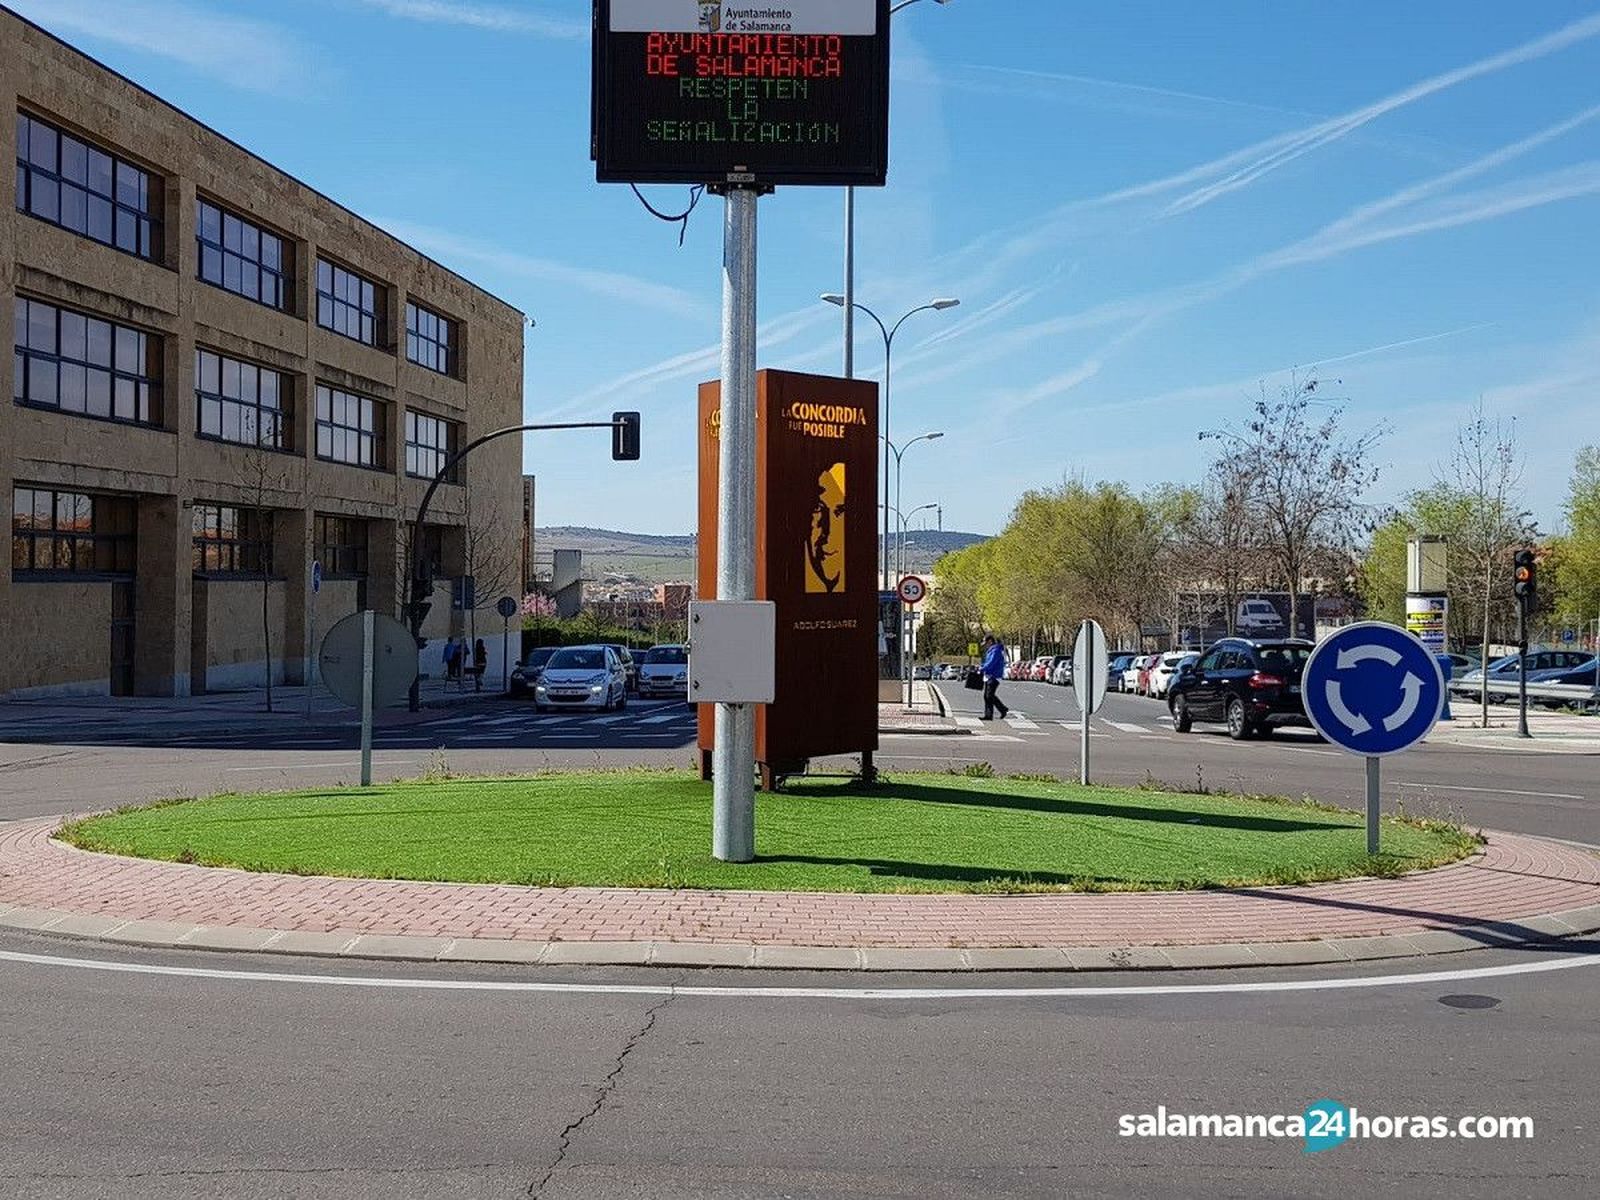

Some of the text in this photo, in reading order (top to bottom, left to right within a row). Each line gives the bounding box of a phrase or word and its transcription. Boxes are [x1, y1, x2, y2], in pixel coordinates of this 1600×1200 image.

[725, 7, 792, 20] Ayuntamiento
[725, 20, 792, 31] de Salamanca
[646, 34, 842, 54] AYUNTAMIENTO
[646, 55, 842, 77] DE SALAMANCA
[679, 78, 808, 99] RESPETEN
[727, 99, 759, 120] LA
[791, 401, 867, 425] CONCORDIA
[803, 422, 846, 438] POSIBLE
[904, 585, 919, 594] 50
